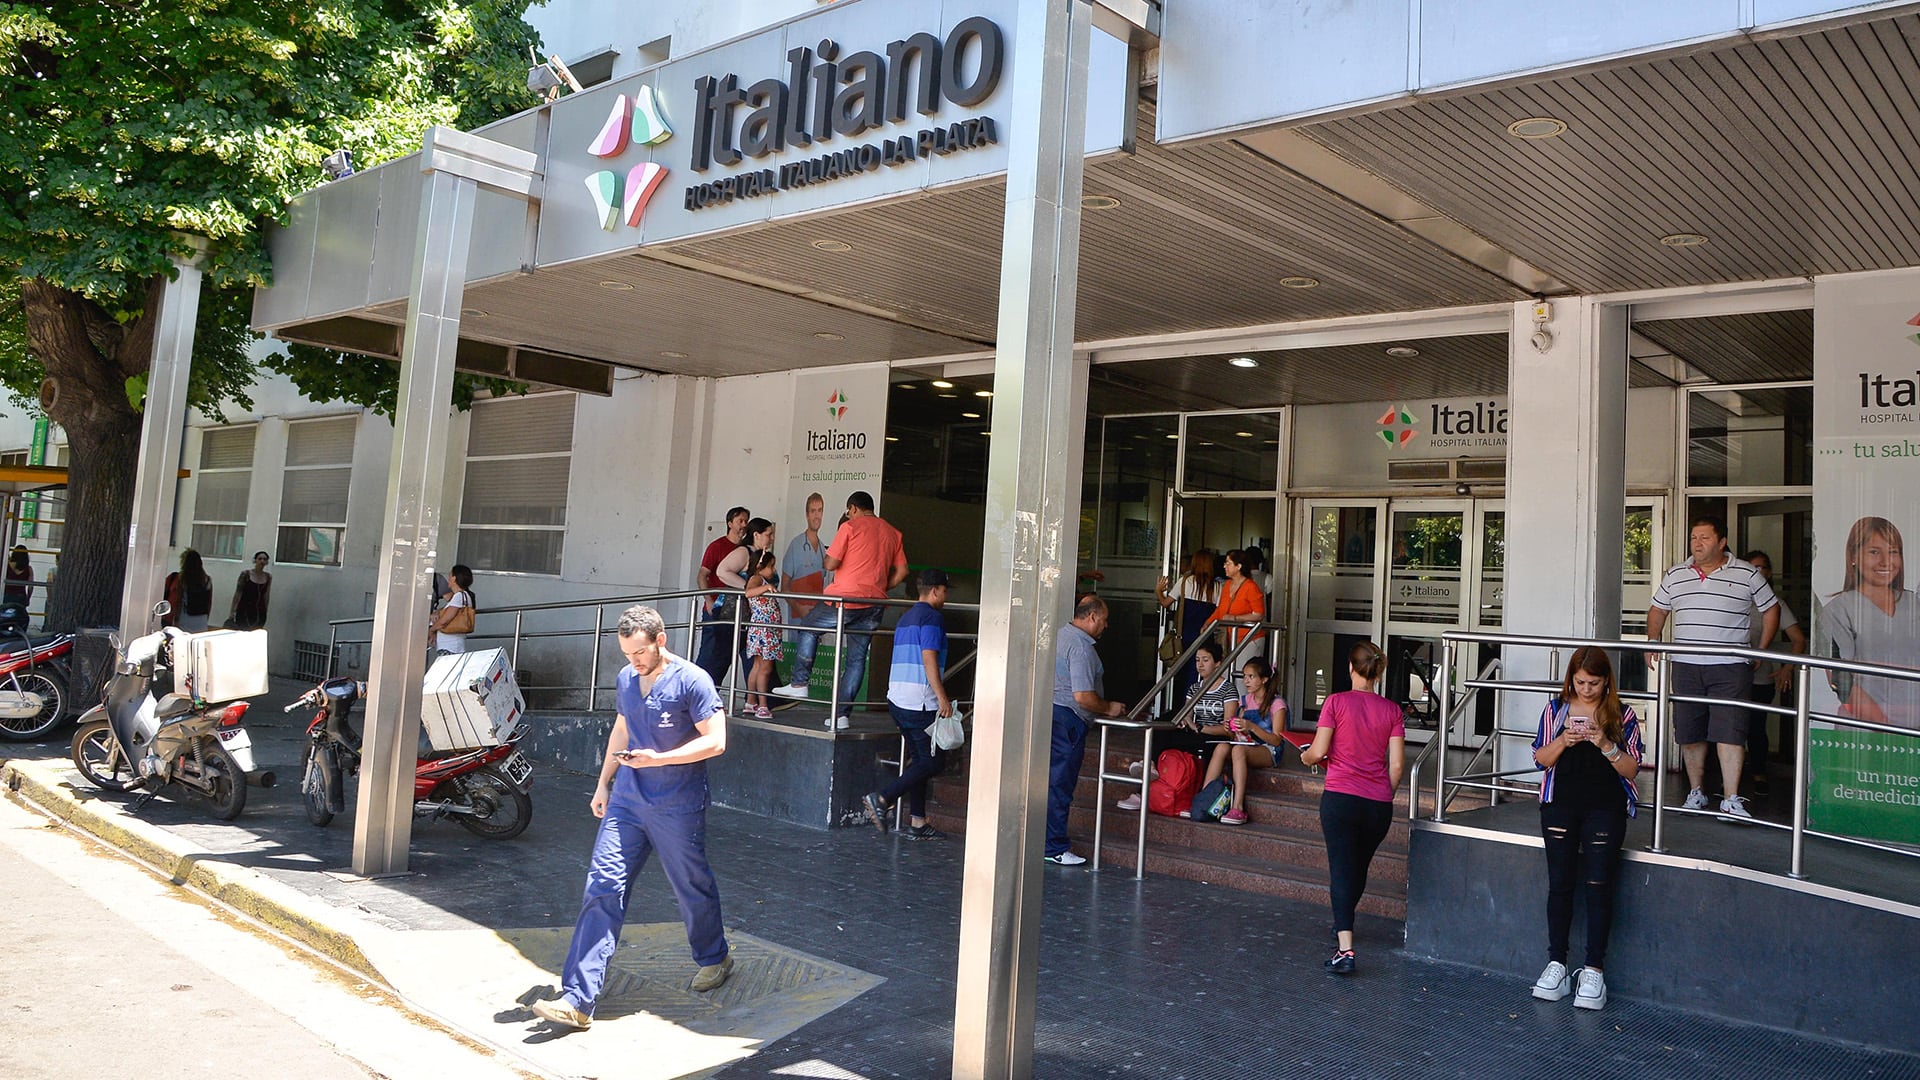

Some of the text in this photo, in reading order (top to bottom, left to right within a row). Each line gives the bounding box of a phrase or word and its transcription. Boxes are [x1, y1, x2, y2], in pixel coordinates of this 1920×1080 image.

[690, 15, 1003, 173] Italiano
[685, 115, 998, 211] HOSPITAL ITALIANO LA PLATA
[1431, 401, 1507, 435] Italia
[1860, 413, 1914, 424] HOSPITAL
[807, 429, 866, 451] Italiano
[1431, 438, 1507, 447] HOSPITAL ITALIAN
[1854, 439, 1920, 459] tu salu
[803, 469, 867, 483] tu salud primero
[1415, 586, 1450, 596] Italiano
[1856, 770, 1920, 786] un nue
[1833, 783, 1854, 799] de
